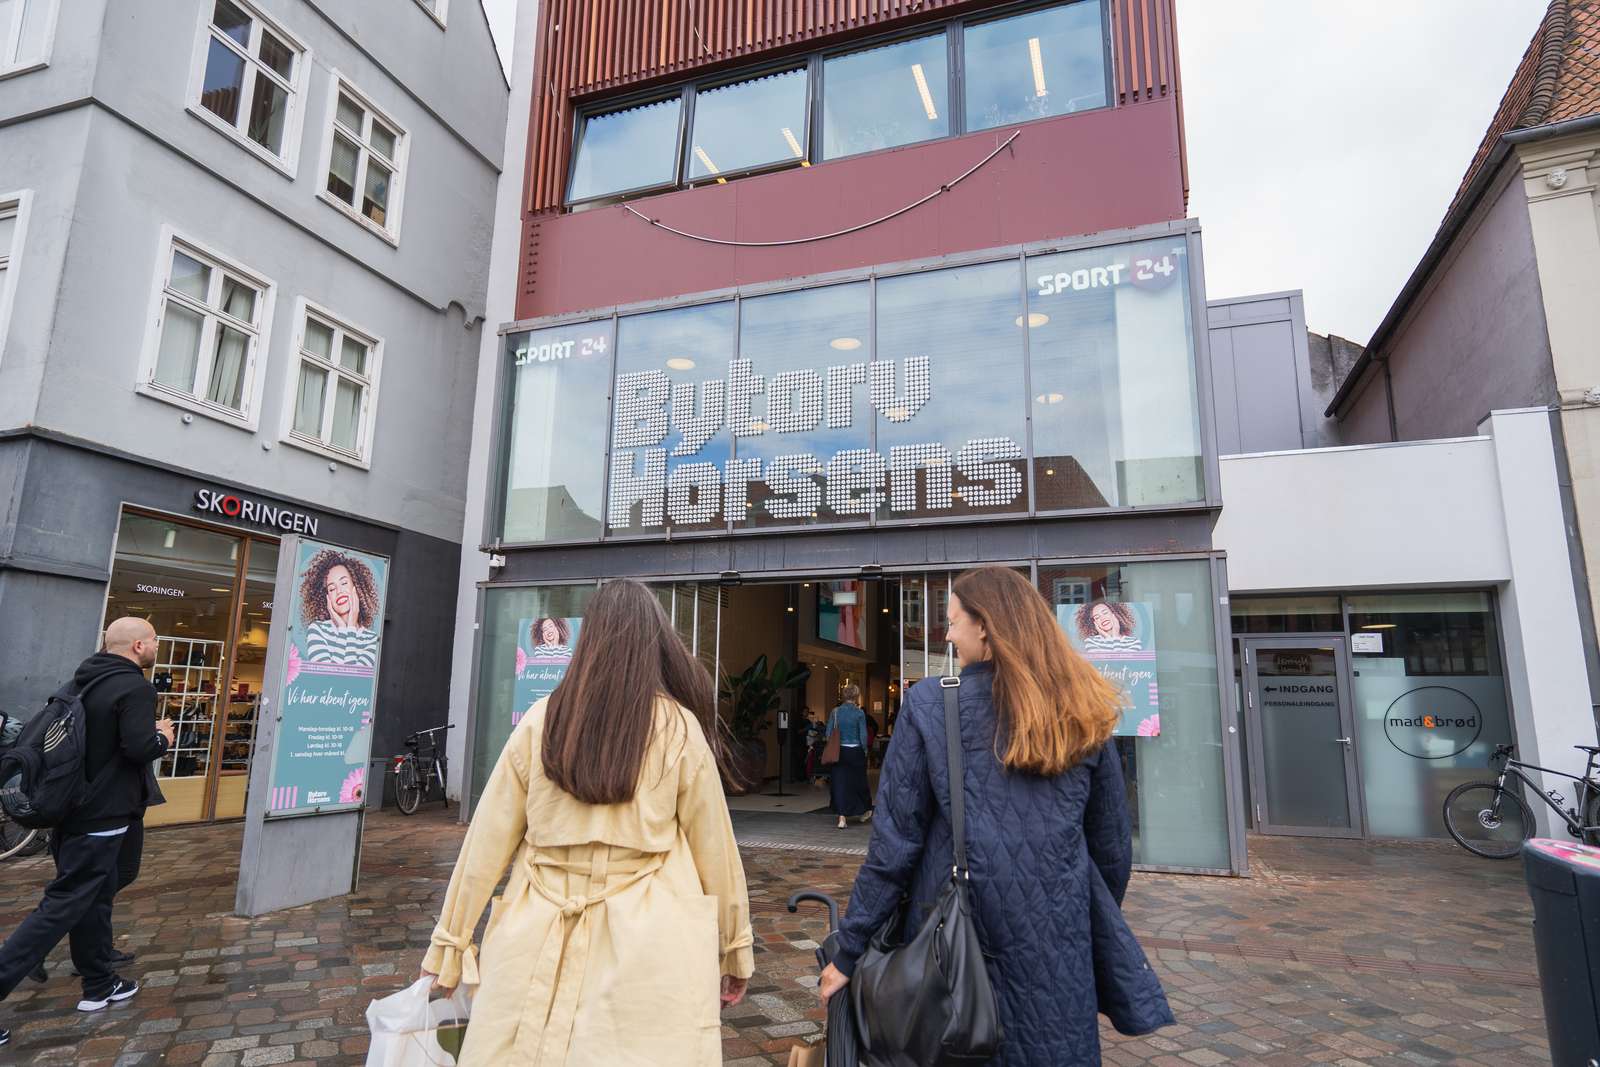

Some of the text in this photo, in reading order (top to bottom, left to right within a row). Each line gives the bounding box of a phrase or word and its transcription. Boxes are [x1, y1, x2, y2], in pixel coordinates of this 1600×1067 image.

[1037, 256, 1174, 296] SPORT 24
[515, 336, 607, 366] SPORT 24
[613, 355, 930, 457] Bytorv
[608, 436, 1024, 529] Horsens
[195, 488, 319, 536] SKORINGEN
[136, 583, 185, 598] SKORINGEN
[287, 686, 370, 715] Vi har åbent igen
[1279, 684, 1334, 694] INDGANG
[1390, 714, 1476, 729] mad&brød
